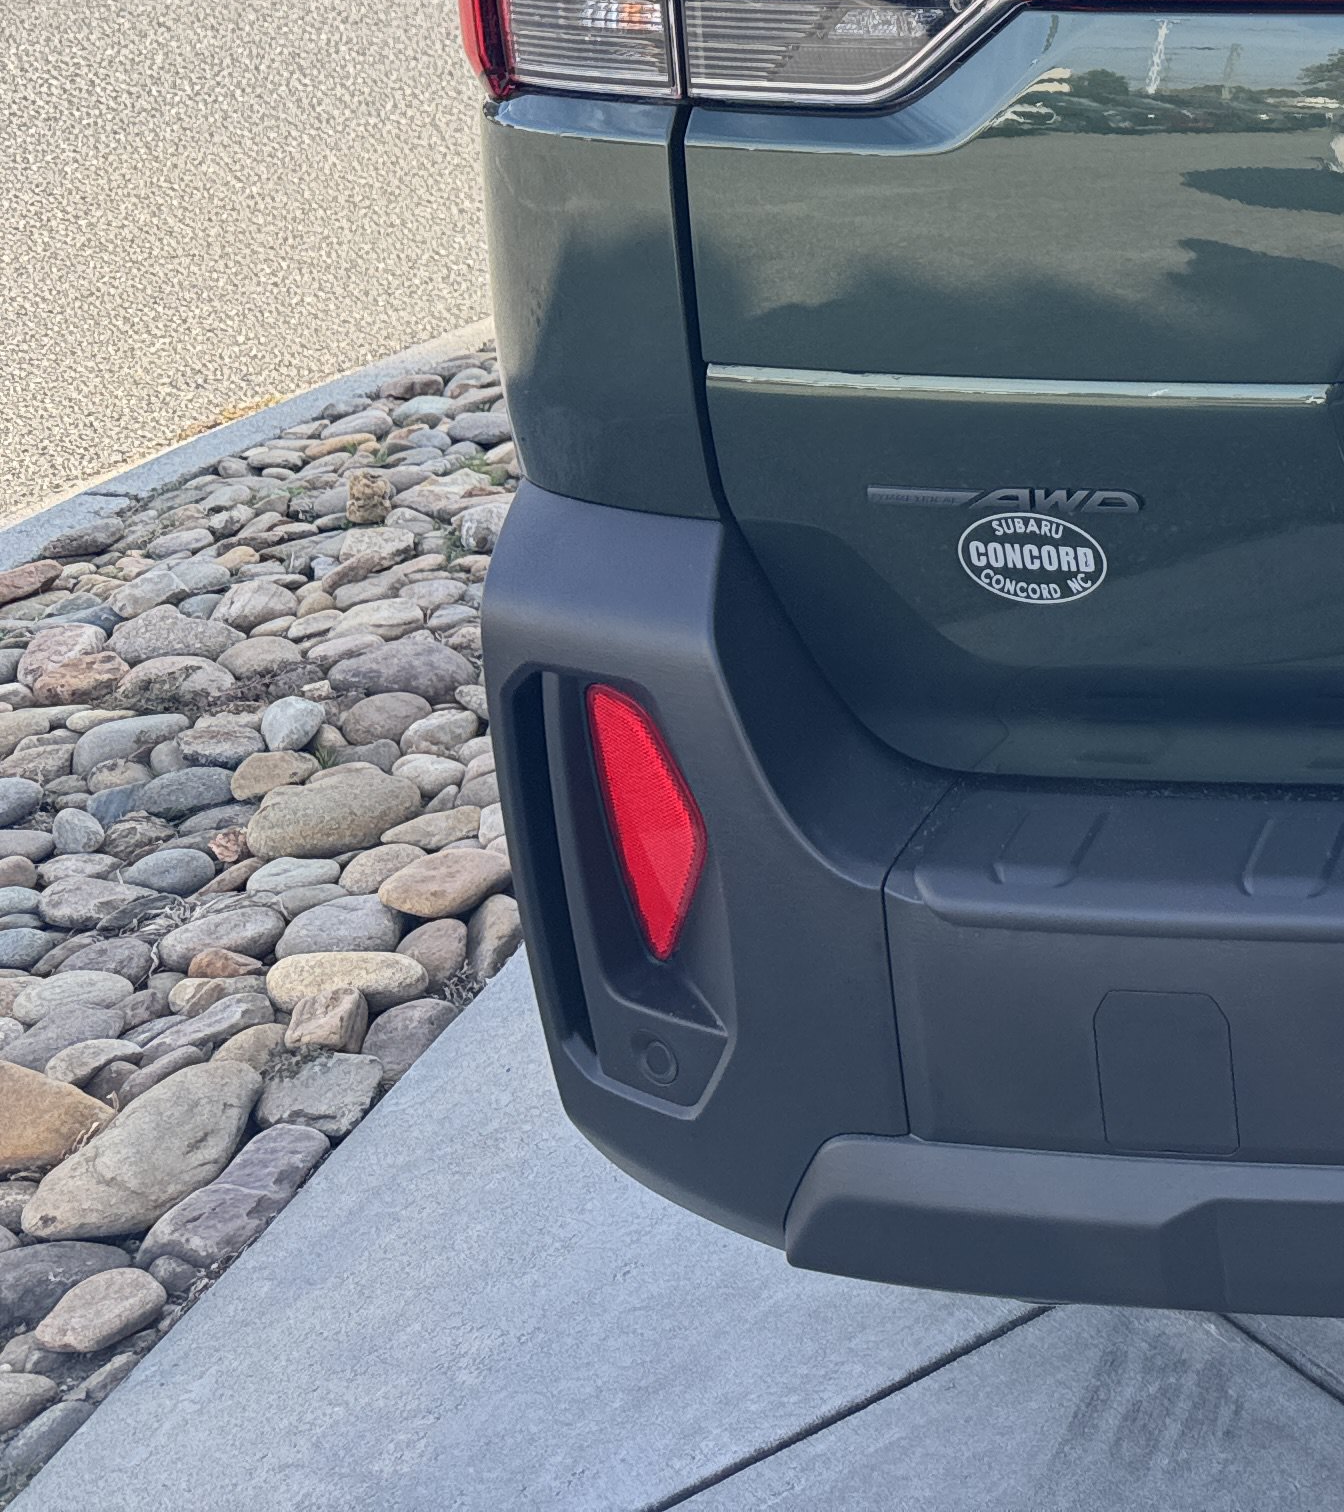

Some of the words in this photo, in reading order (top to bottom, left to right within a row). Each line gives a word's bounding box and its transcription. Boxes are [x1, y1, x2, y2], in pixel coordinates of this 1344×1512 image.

[968, 488, 1142, 513] AWD
[991, 518, 1064, 539] SUBARU
[968, 540, 1096, 573] CONCORD
[980, 568, 1061, 600] CONCORD
[1066, 573, 1092, 594] NC
